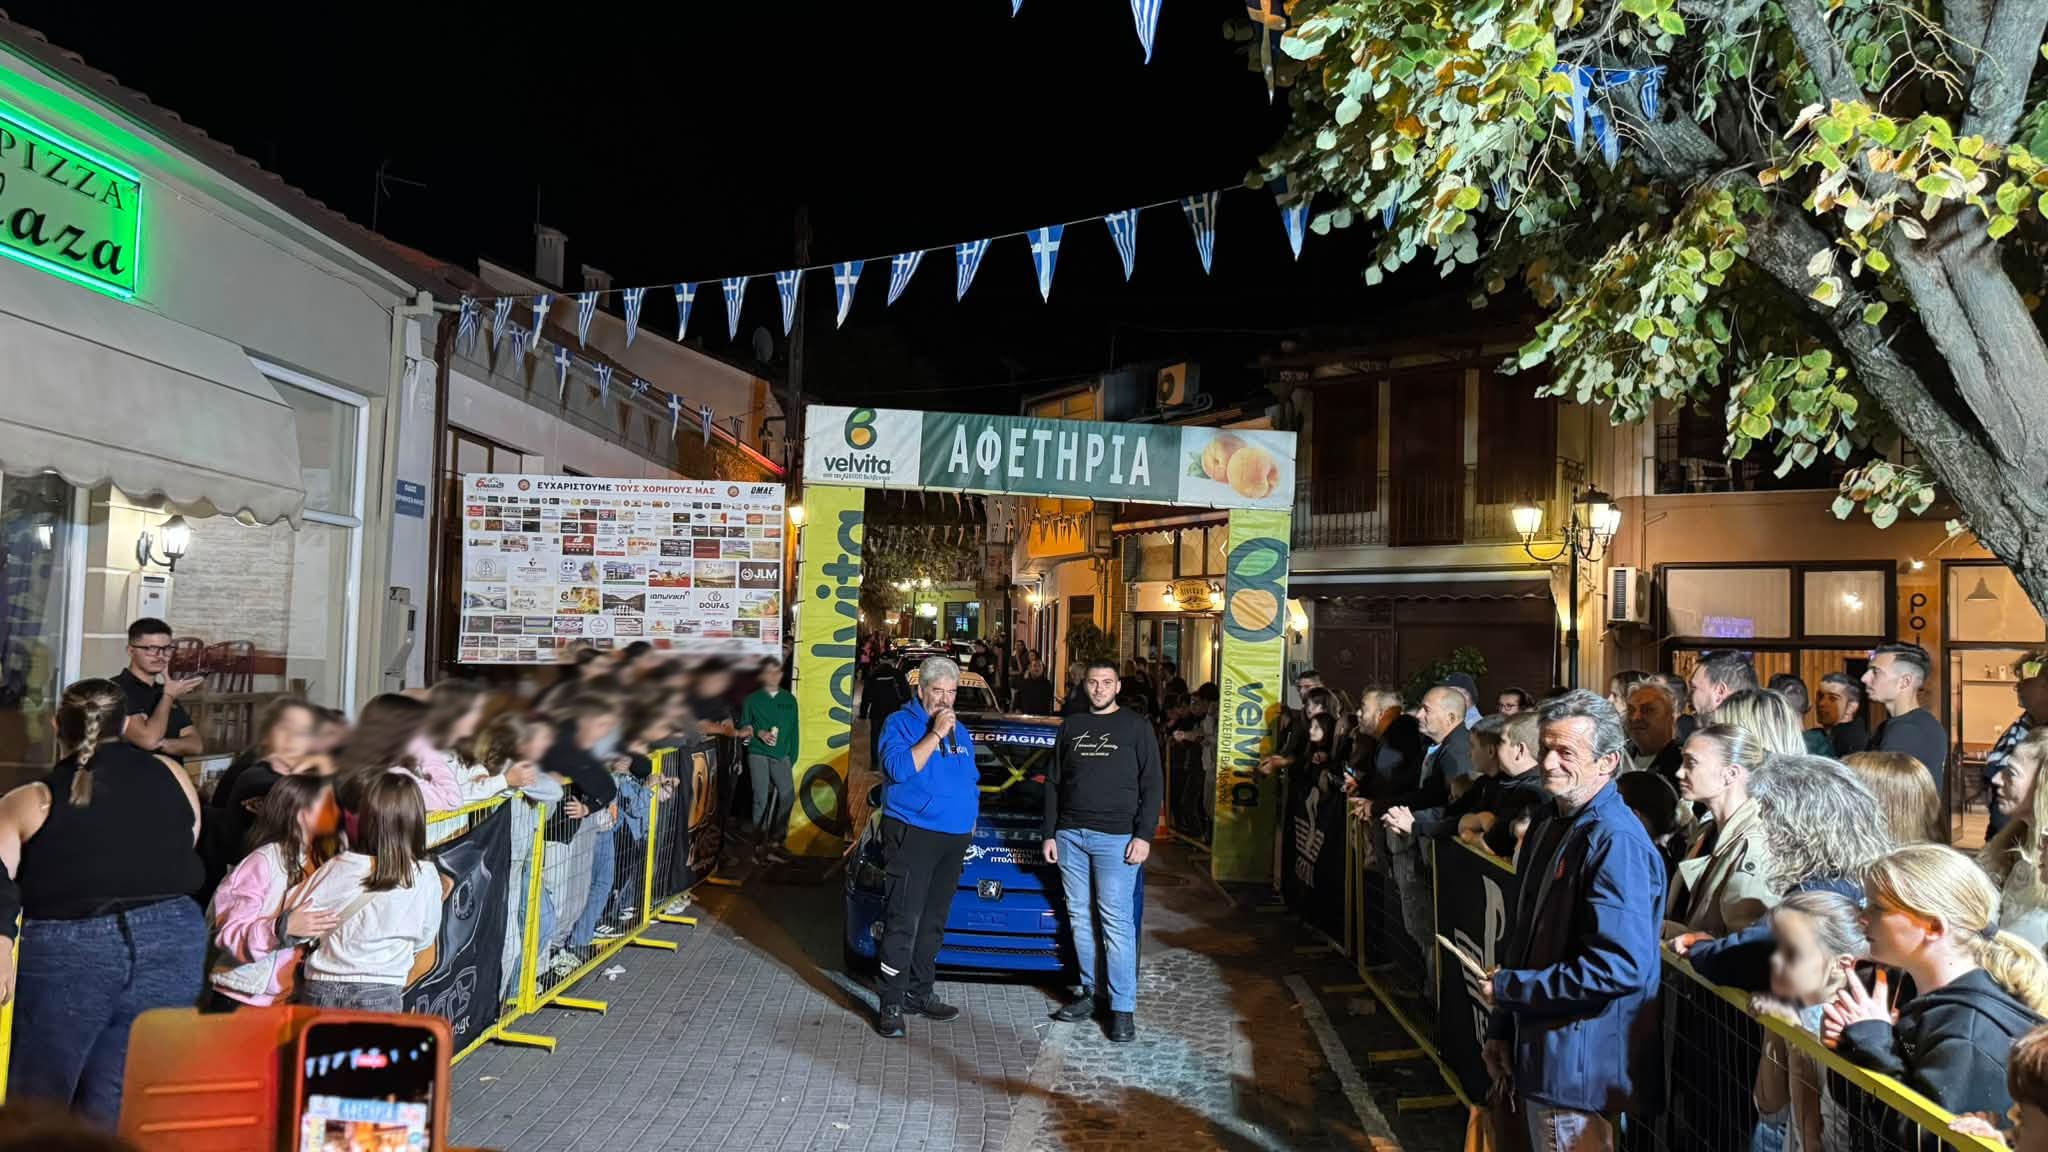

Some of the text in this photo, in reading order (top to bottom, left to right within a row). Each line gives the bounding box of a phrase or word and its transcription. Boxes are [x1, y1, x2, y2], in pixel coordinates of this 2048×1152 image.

[947, 423, 1151, 486] ΑΦΕΤΗΡΙΑ
[824, 452, 891, 474] velvita
[537, 482, 716, 495] ΕΥΧΑΡΙΣΤΟΥΜΕ ΤΟΥΣ ΧΟΡΗΓΟΥΣ ΜΑΣ
[754, 568, 777, 580] JLM
[699, 602, 730, 610] DOUFAS
